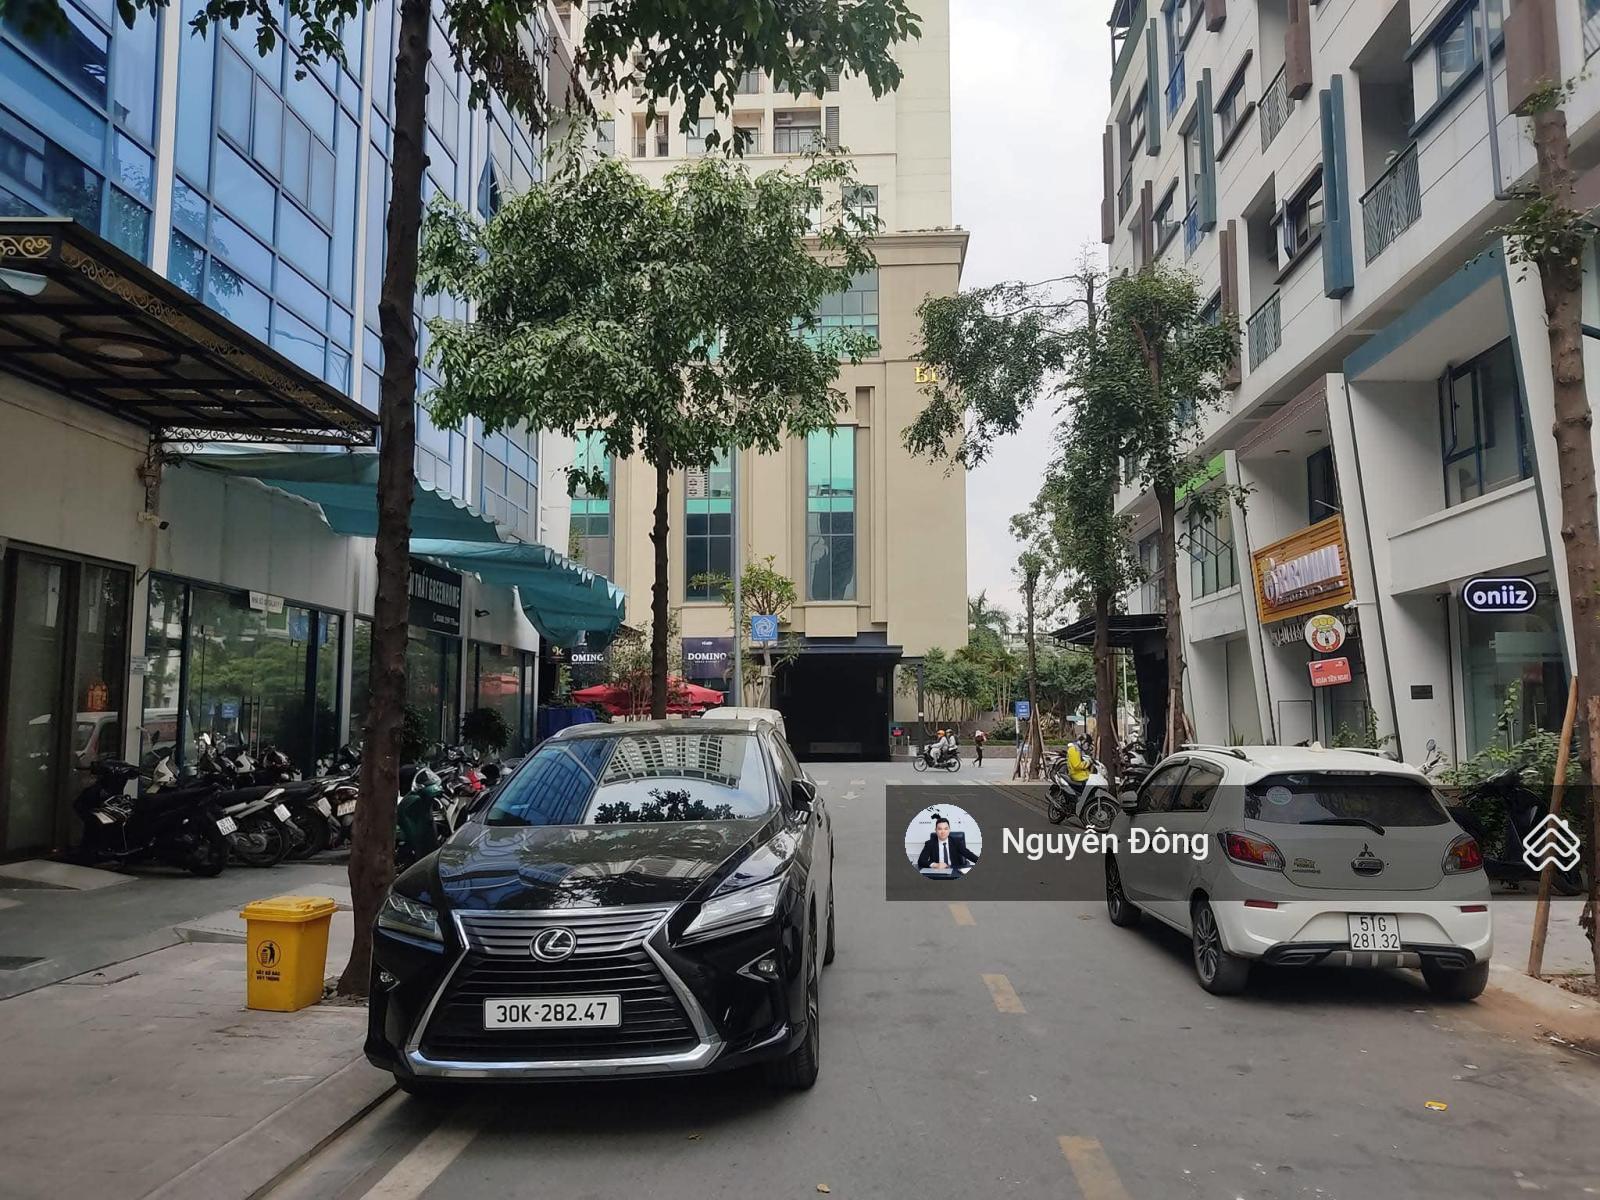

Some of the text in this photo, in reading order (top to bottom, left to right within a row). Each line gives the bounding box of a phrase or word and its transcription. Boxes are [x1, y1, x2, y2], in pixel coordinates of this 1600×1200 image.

[1472, 585, 1528, 605] oniiz
[687, 652, 727, 661] DOMINO
[1360, 916, 1387, 932] 51G
[1352, 933, 1399, 949] 281.32
[496, 1002, 608, 1023] 30K-282.47
